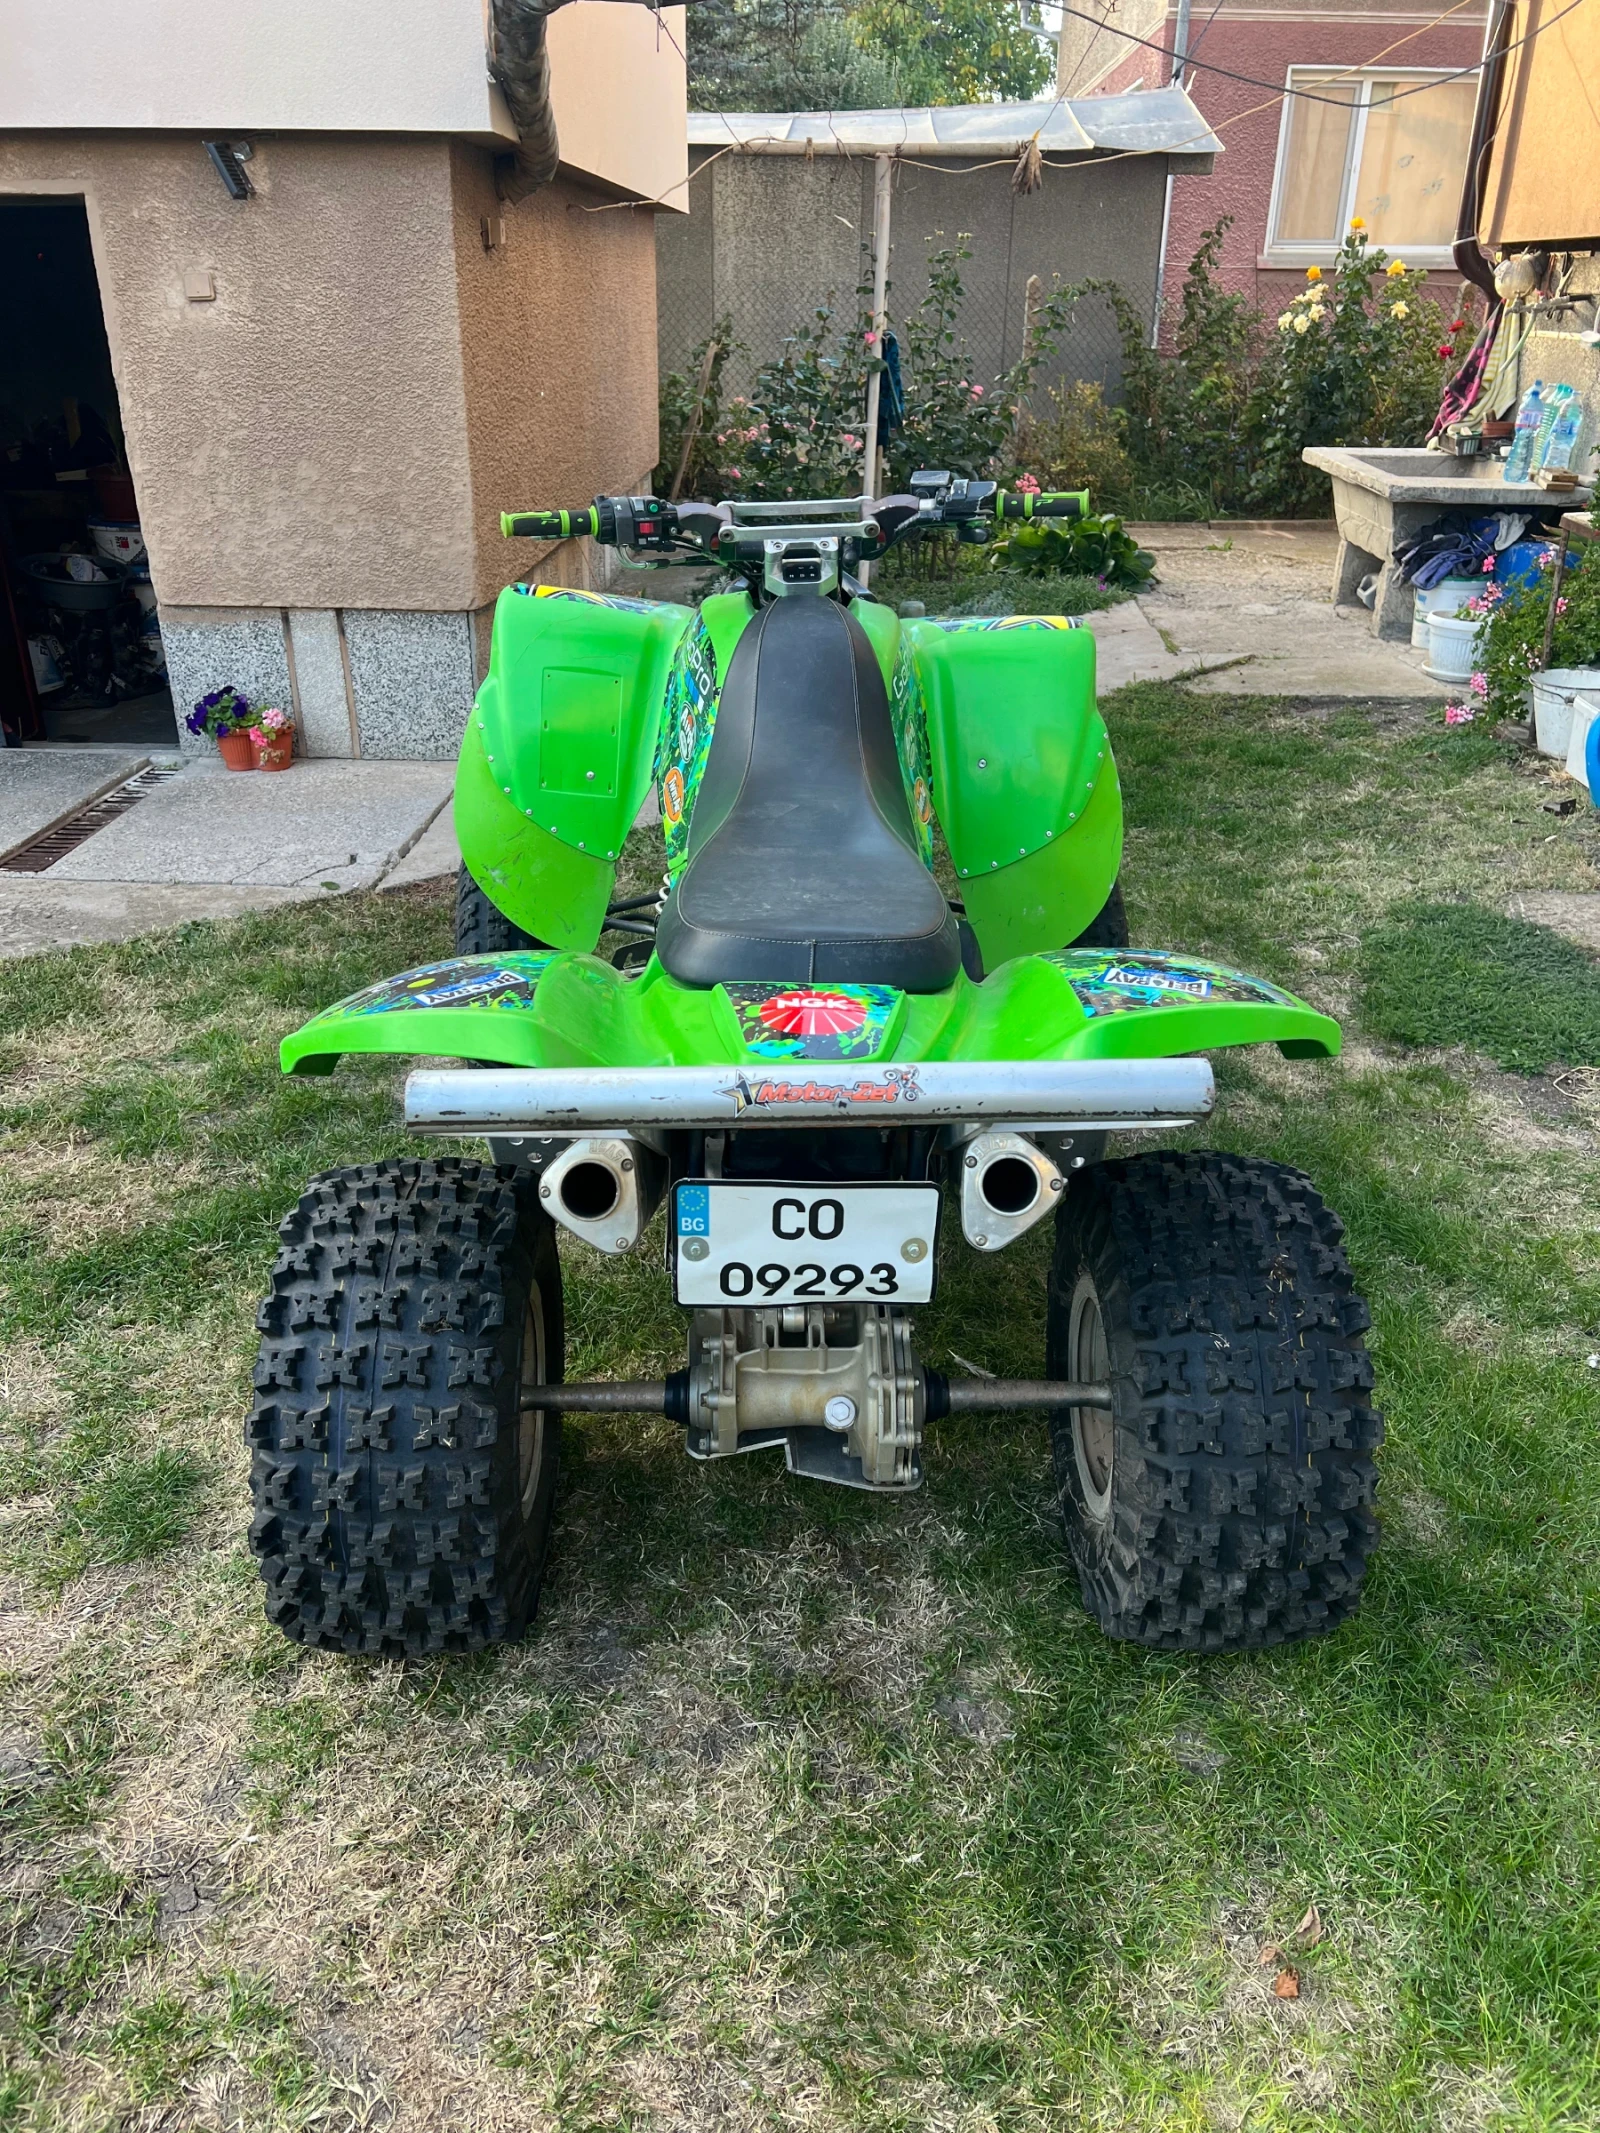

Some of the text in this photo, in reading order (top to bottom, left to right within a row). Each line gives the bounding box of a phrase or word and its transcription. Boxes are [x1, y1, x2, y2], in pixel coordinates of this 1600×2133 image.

[776, 997, 850, 1010] NGK
[756, 1080, 901, 1105] Motor-Zet
[681, 1217, 705, 1232] BG
[772, 1198, 845, 1241] CO
[719, 1262, 900, 1298] 09293
